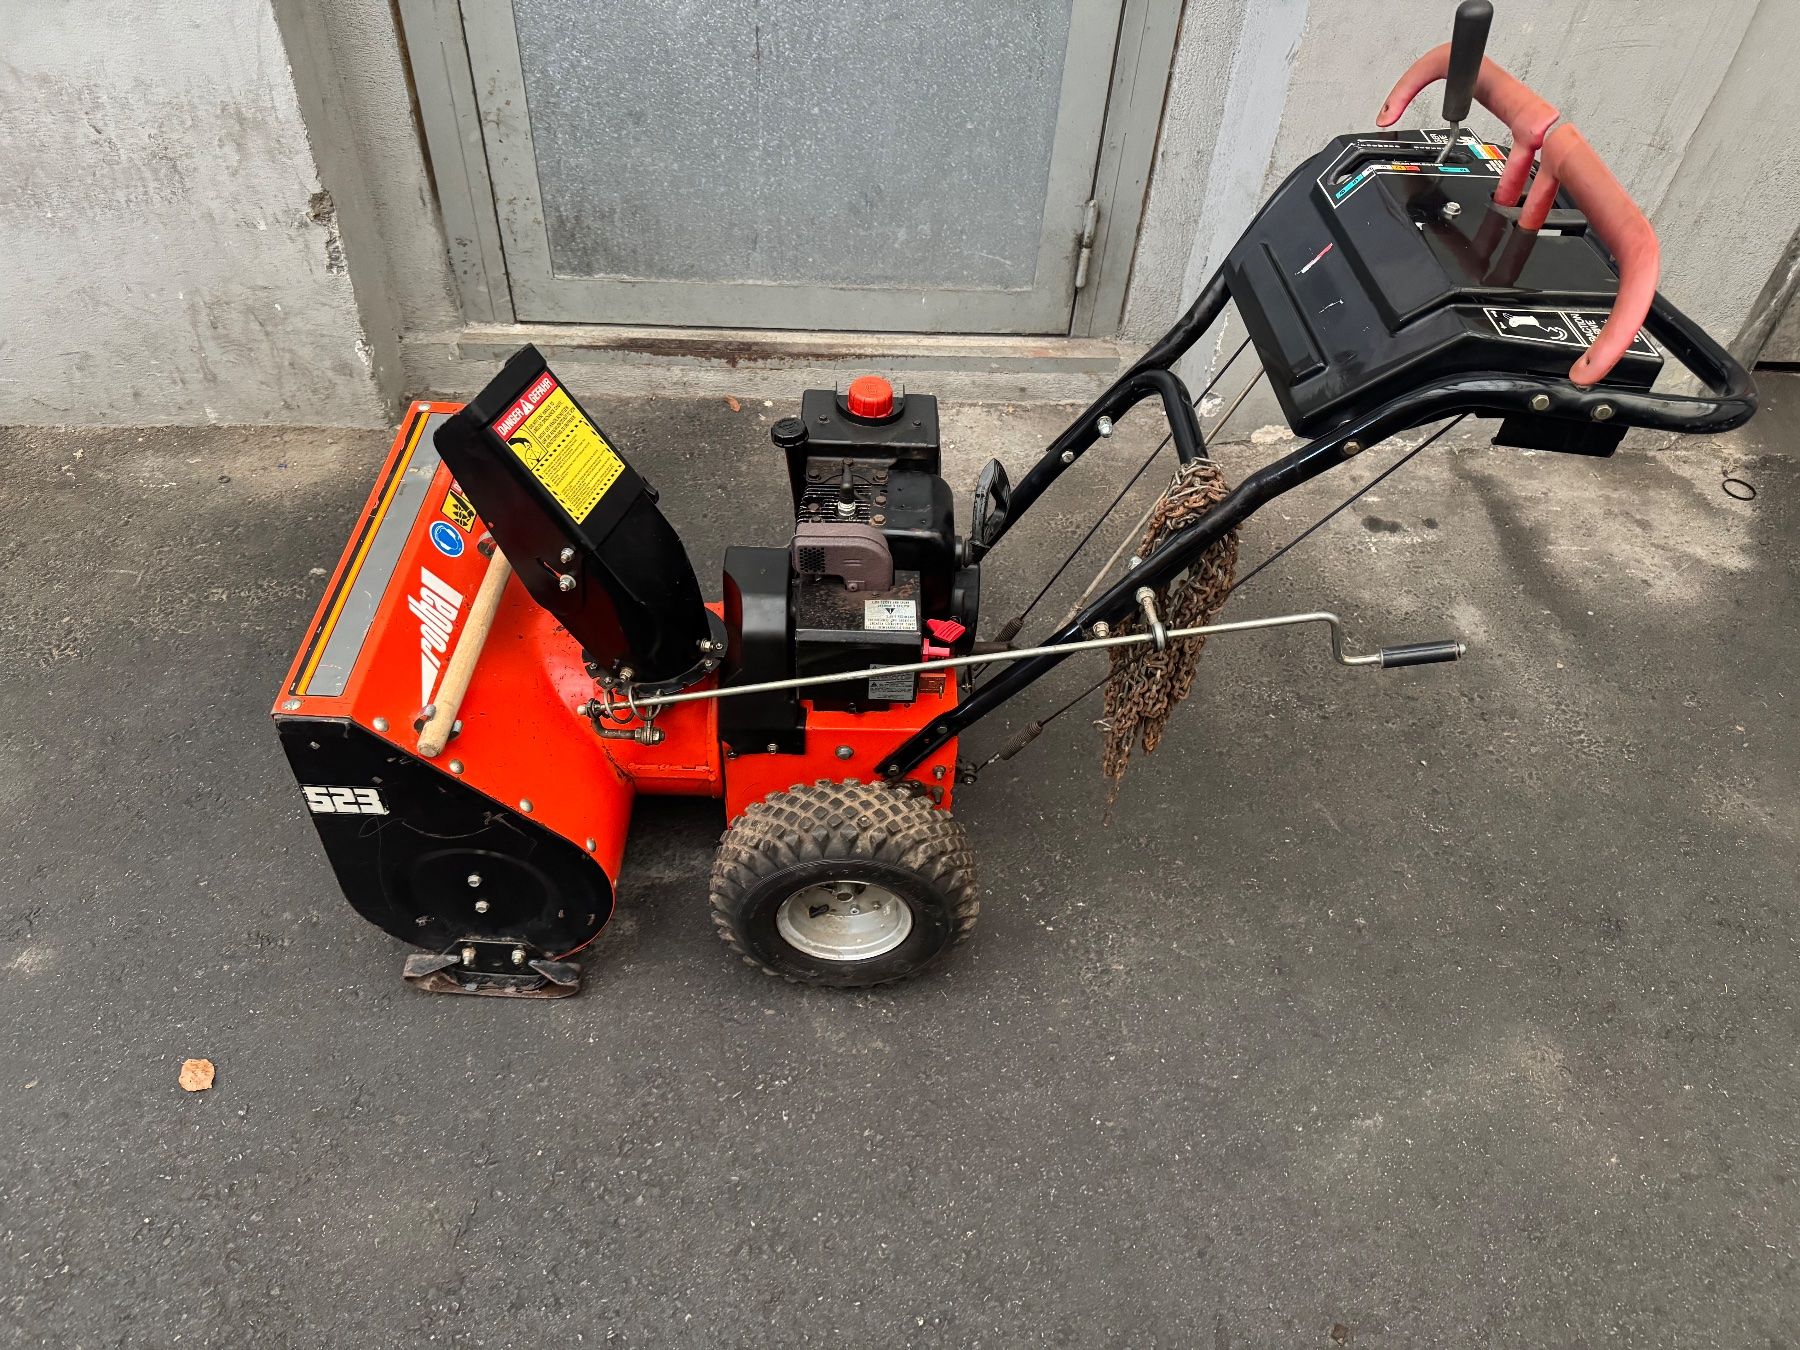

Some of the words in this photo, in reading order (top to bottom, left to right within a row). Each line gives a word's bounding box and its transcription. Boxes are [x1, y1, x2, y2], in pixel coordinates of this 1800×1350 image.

[1571, 313, 1598, 344] RACTION
[497, 407, 525, 437] DANGER
[527, 377, 553, 404] GEFAHR
[408, 578, 461, 676] rolba
[303, 786, 386, 815] 523
